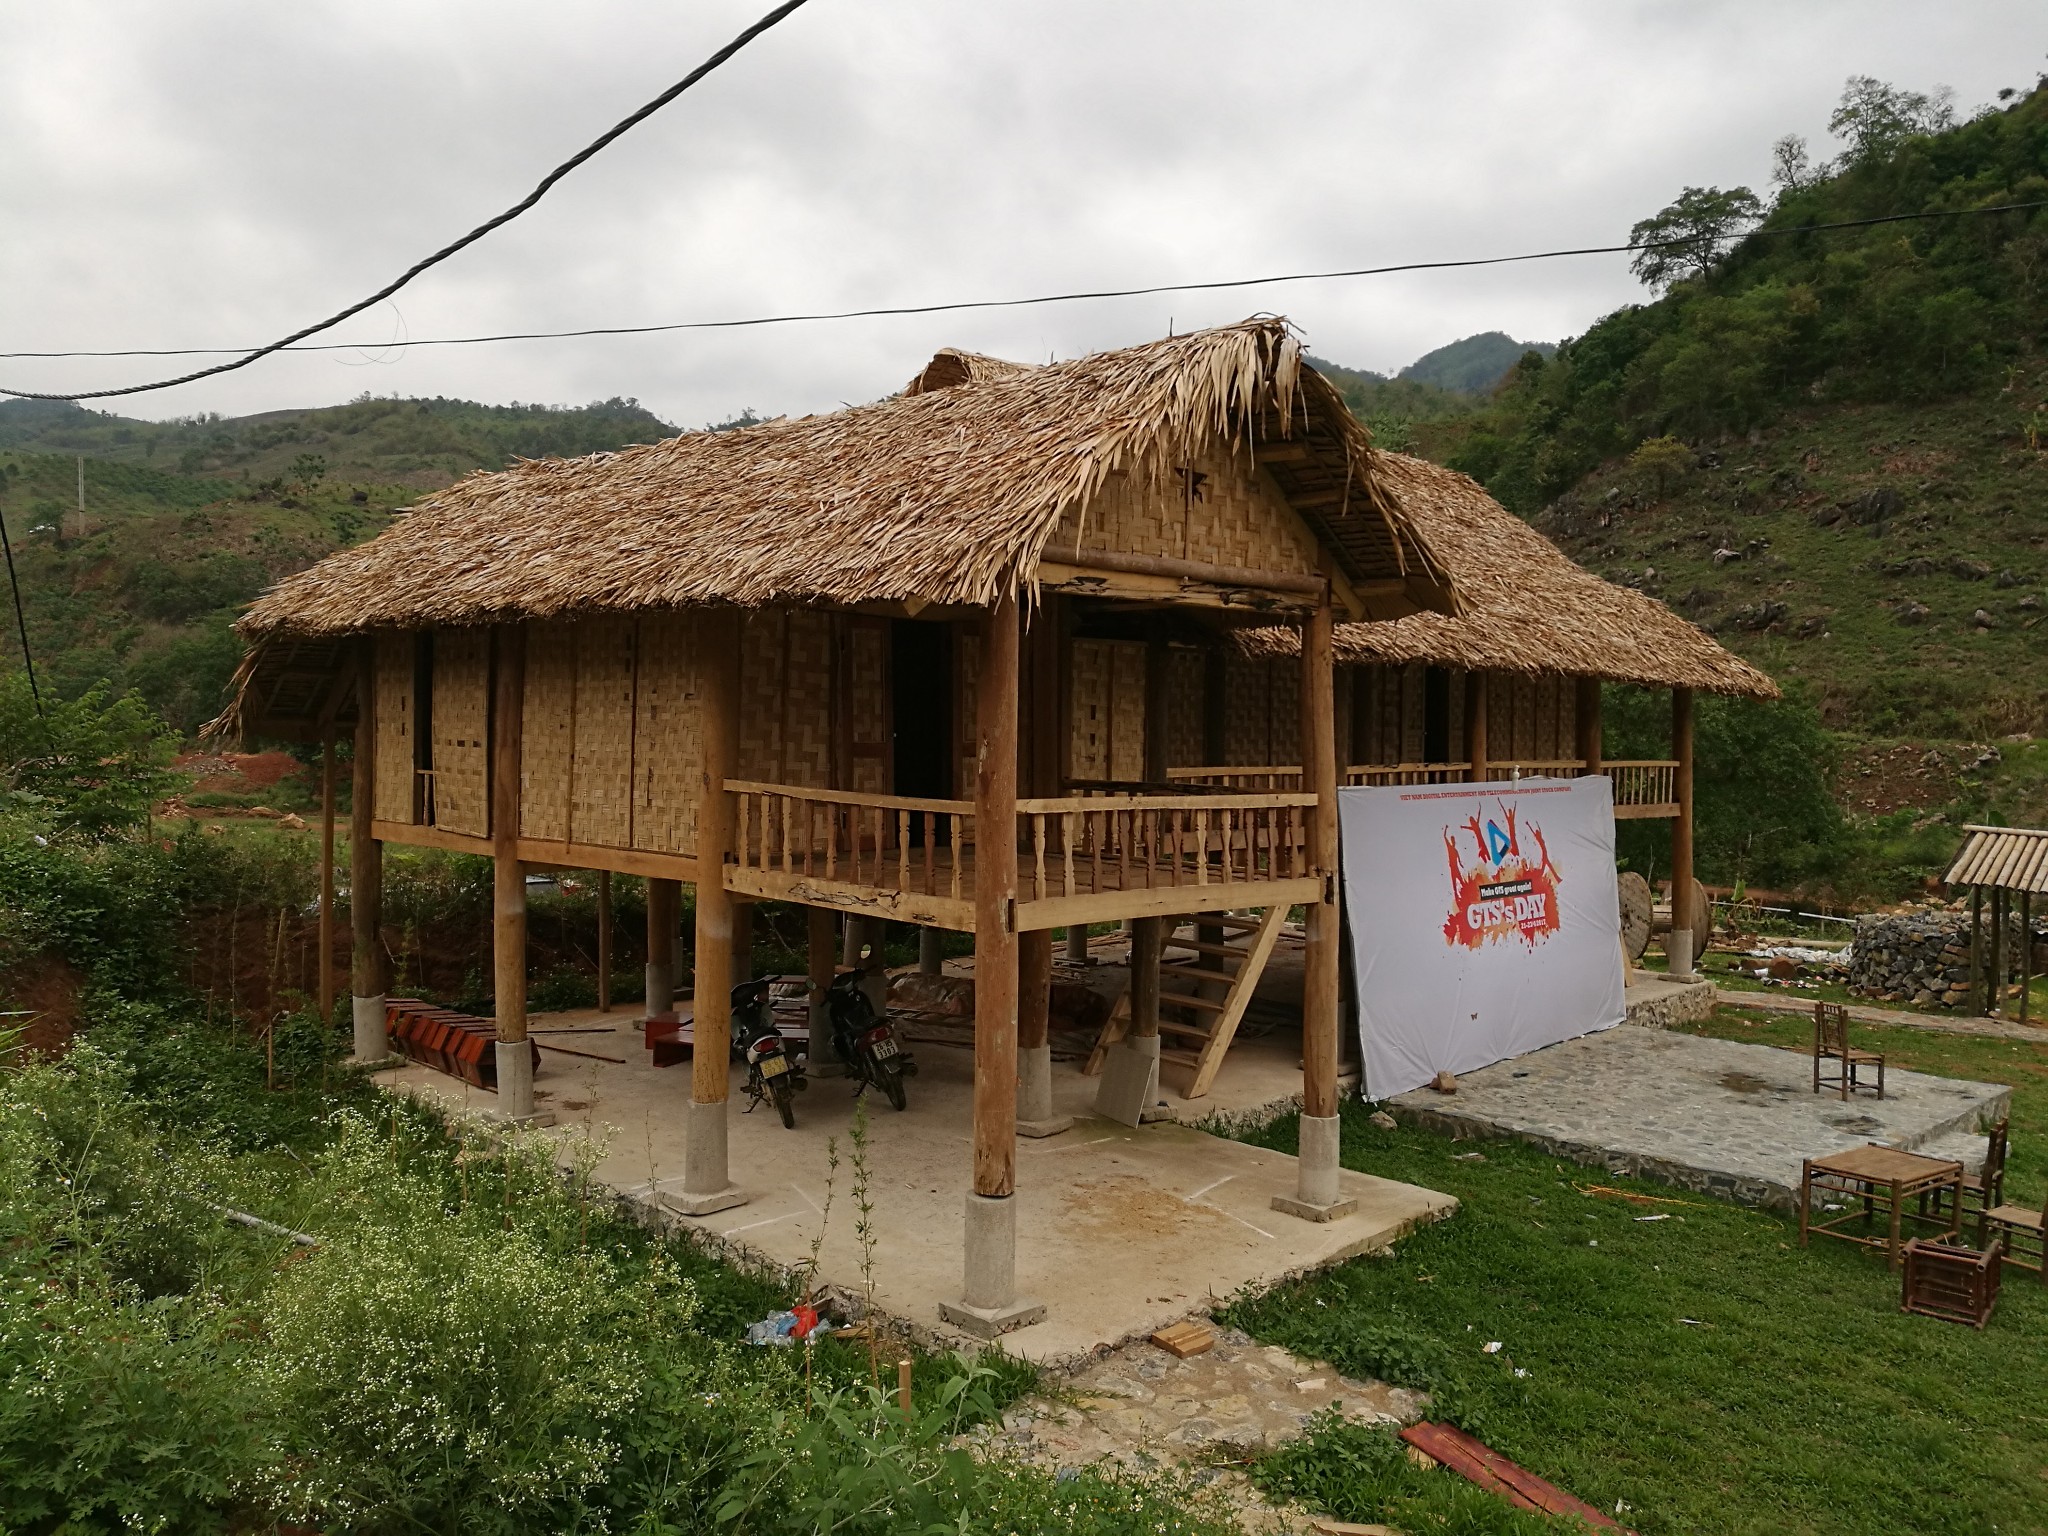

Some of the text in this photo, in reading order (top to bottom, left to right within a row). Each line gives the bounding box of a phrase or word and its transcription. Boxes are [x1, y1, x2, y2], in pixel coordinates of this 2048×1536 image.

[1480, 882, 1532, 897] Make GTS great again!
[1467, 894, 1545, 929] GTS's DAY
[879, 1046, 895, 1058] 3303
